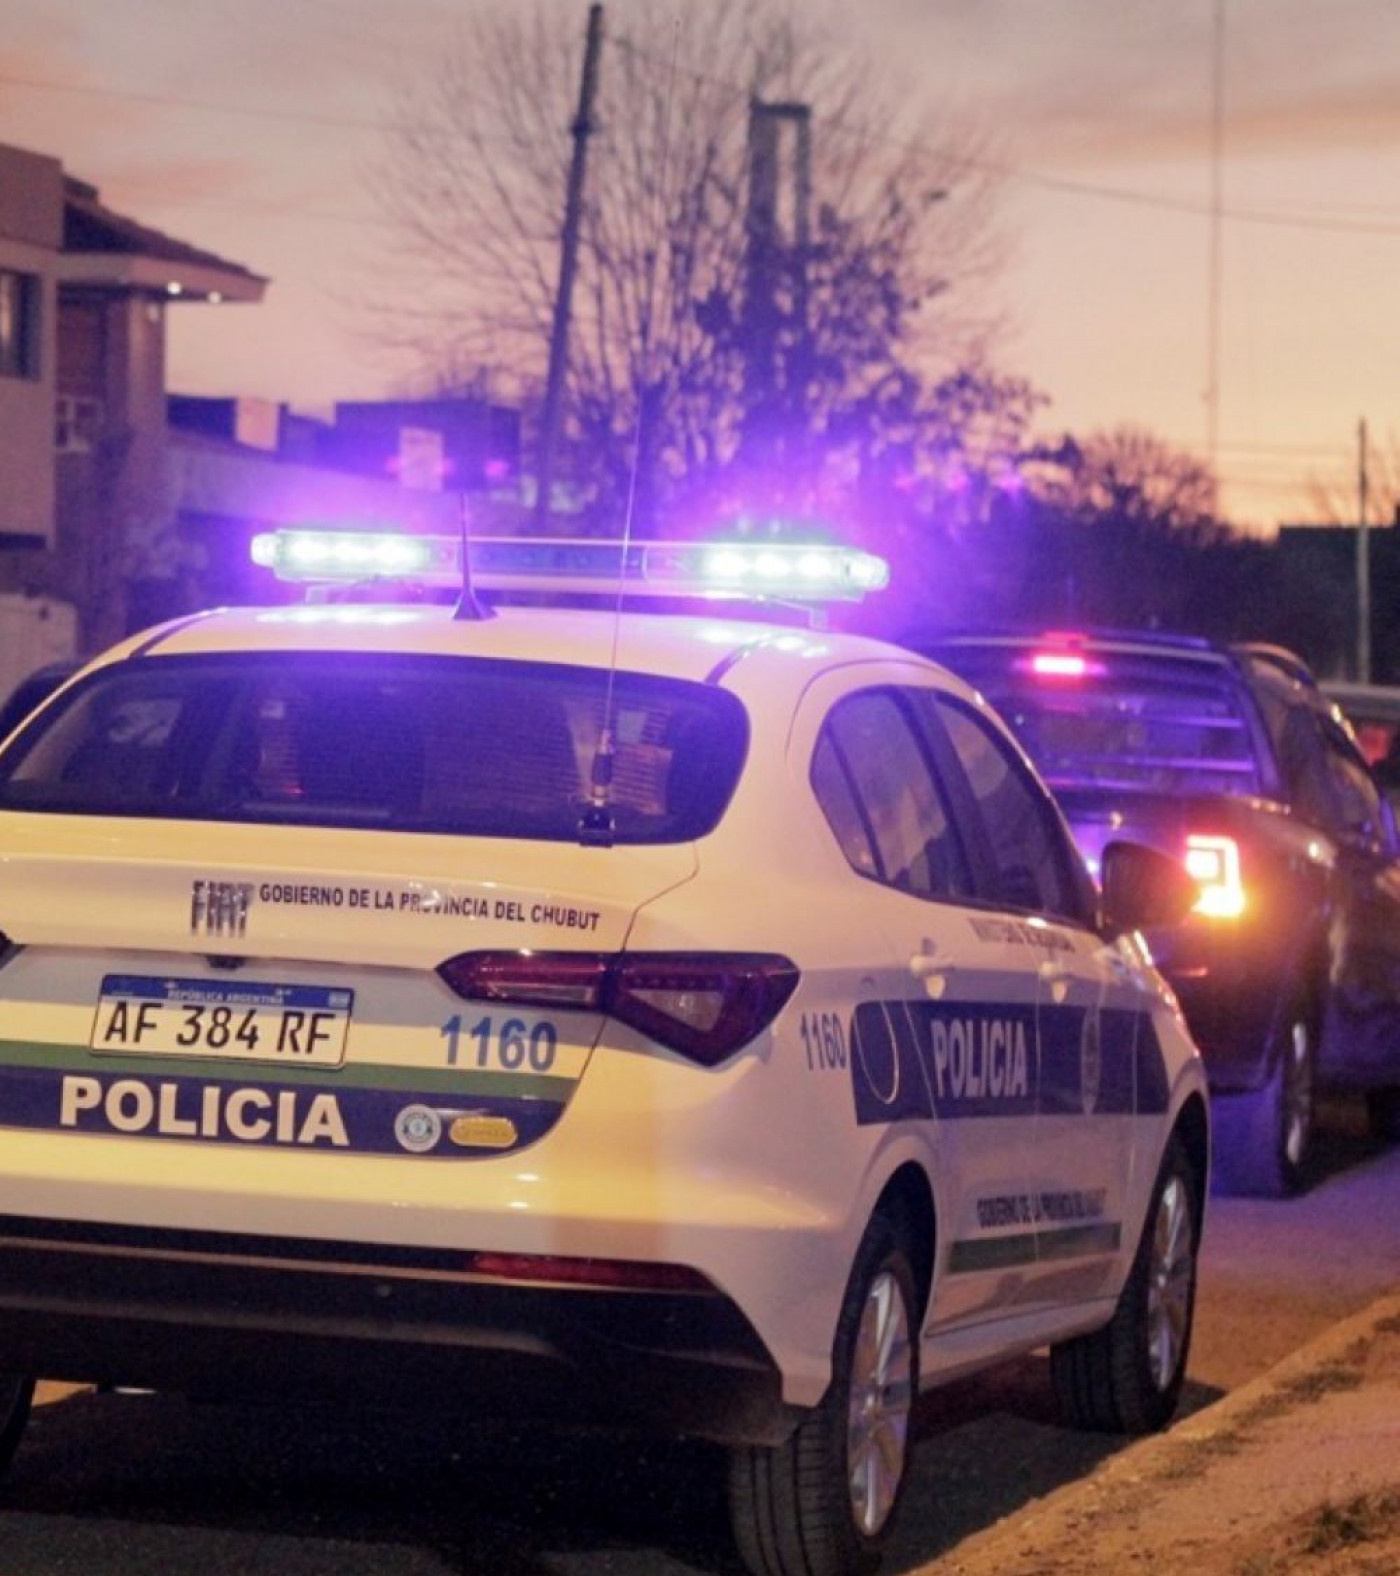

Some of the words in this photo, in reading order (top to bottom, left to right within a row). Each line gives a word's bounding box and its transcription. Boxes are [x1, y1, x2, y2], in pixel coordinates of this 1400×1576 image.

[260, 884, 343, 906] GOBIERNO
[349, 888, 370, 908] DE
[375, 890, 394, 910] LA
[494, 901, 525, 922] DEL
[531, 905, 600, 931] CHUBUT
[104, 1001, 163, 1043] AF
[176, 1005, 259, 1050] 384
[277, 1011, 336, 1054] RF
[441, 1014, 557, 1071] 1160
[800, 1012, 847, 1071] 1160
[931, 1019, 1027, 1098] POLICIA
[60, 1075, 350, 1147] POLICIA
